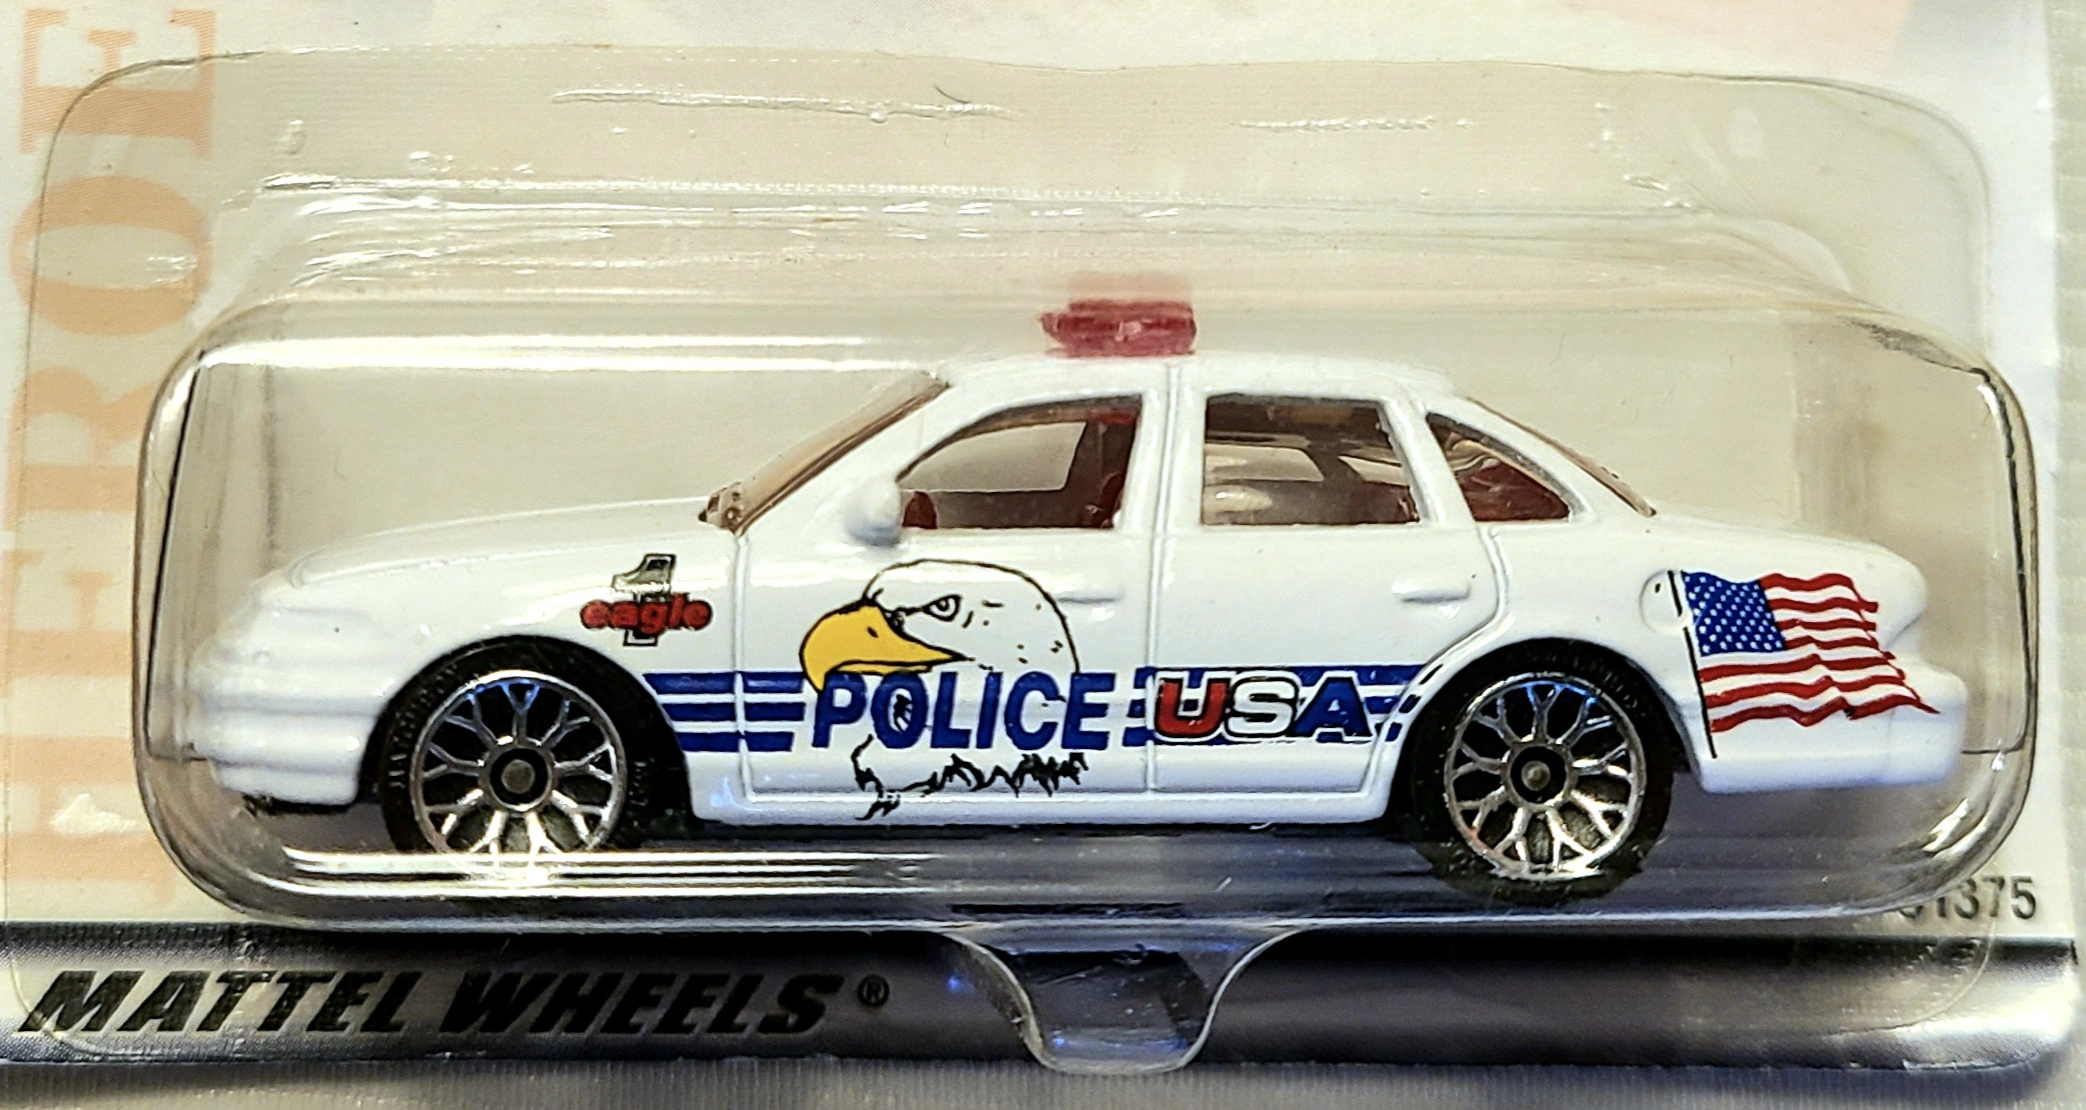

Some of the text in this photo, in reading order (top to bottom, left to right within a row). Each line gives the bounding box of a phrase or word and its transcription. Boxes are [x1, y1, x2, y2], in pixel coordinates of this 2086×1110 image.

[579, 592, 713, 637] eagle
[811, 671, 1374, 751] POLICE USA
[18, 969, 423, 1034] MATTEL
[438, 971, 844, 1034] WHEELS
